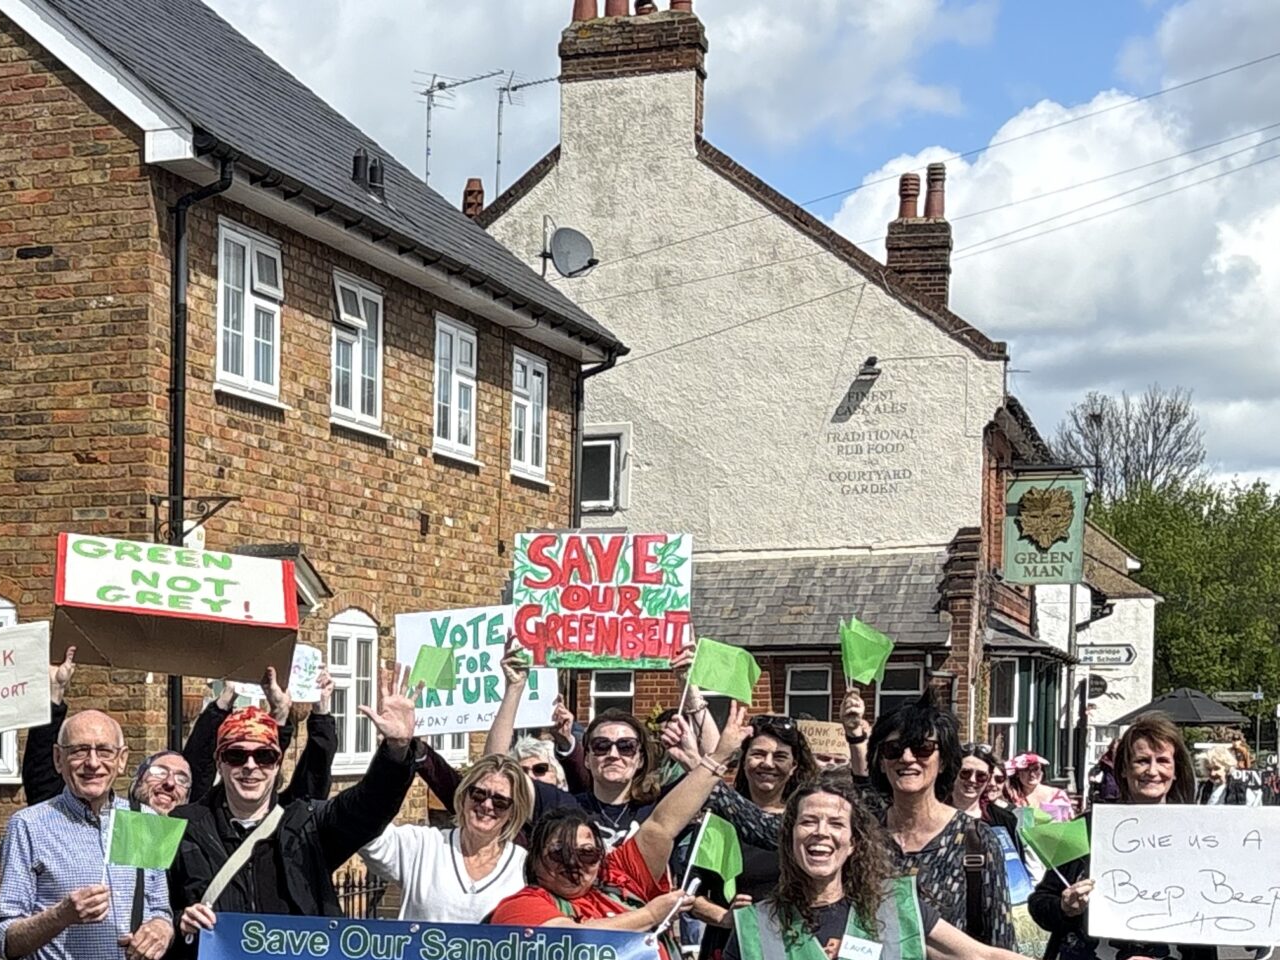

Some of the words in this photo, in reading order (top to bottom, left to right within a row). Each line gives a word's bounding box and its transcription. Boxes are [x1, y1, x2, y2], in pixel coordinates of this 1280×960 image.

[867, 443, 905, 454] FOOD
[841, 483, 898, 495] GARDEN
[72, 539, 233, 570] GREEN
[522, 534, 668, 589] SAVE
[1014, 551, 1074, 565] GREEN
[131, 570, 240, 597] NOT
[1022, 565, 1064, 578] MAN
[560, 585, 643, 616] OUR
[430, 613, 506, 650] VOTE
[514, 603, 690, 667] GREENBELT
[455, 651, 492, 674] FOR
[457, 713, 470, 724] OF
[477, 713, 497, 723] ACT
[1112, 818, 1173, 853] GIVE
[1243, 829, 1263, 850] A
[1101, 868, 1185, 917] Beep
[241, 919, 330, 957] Save
[340, 924, 412, 960] Our
